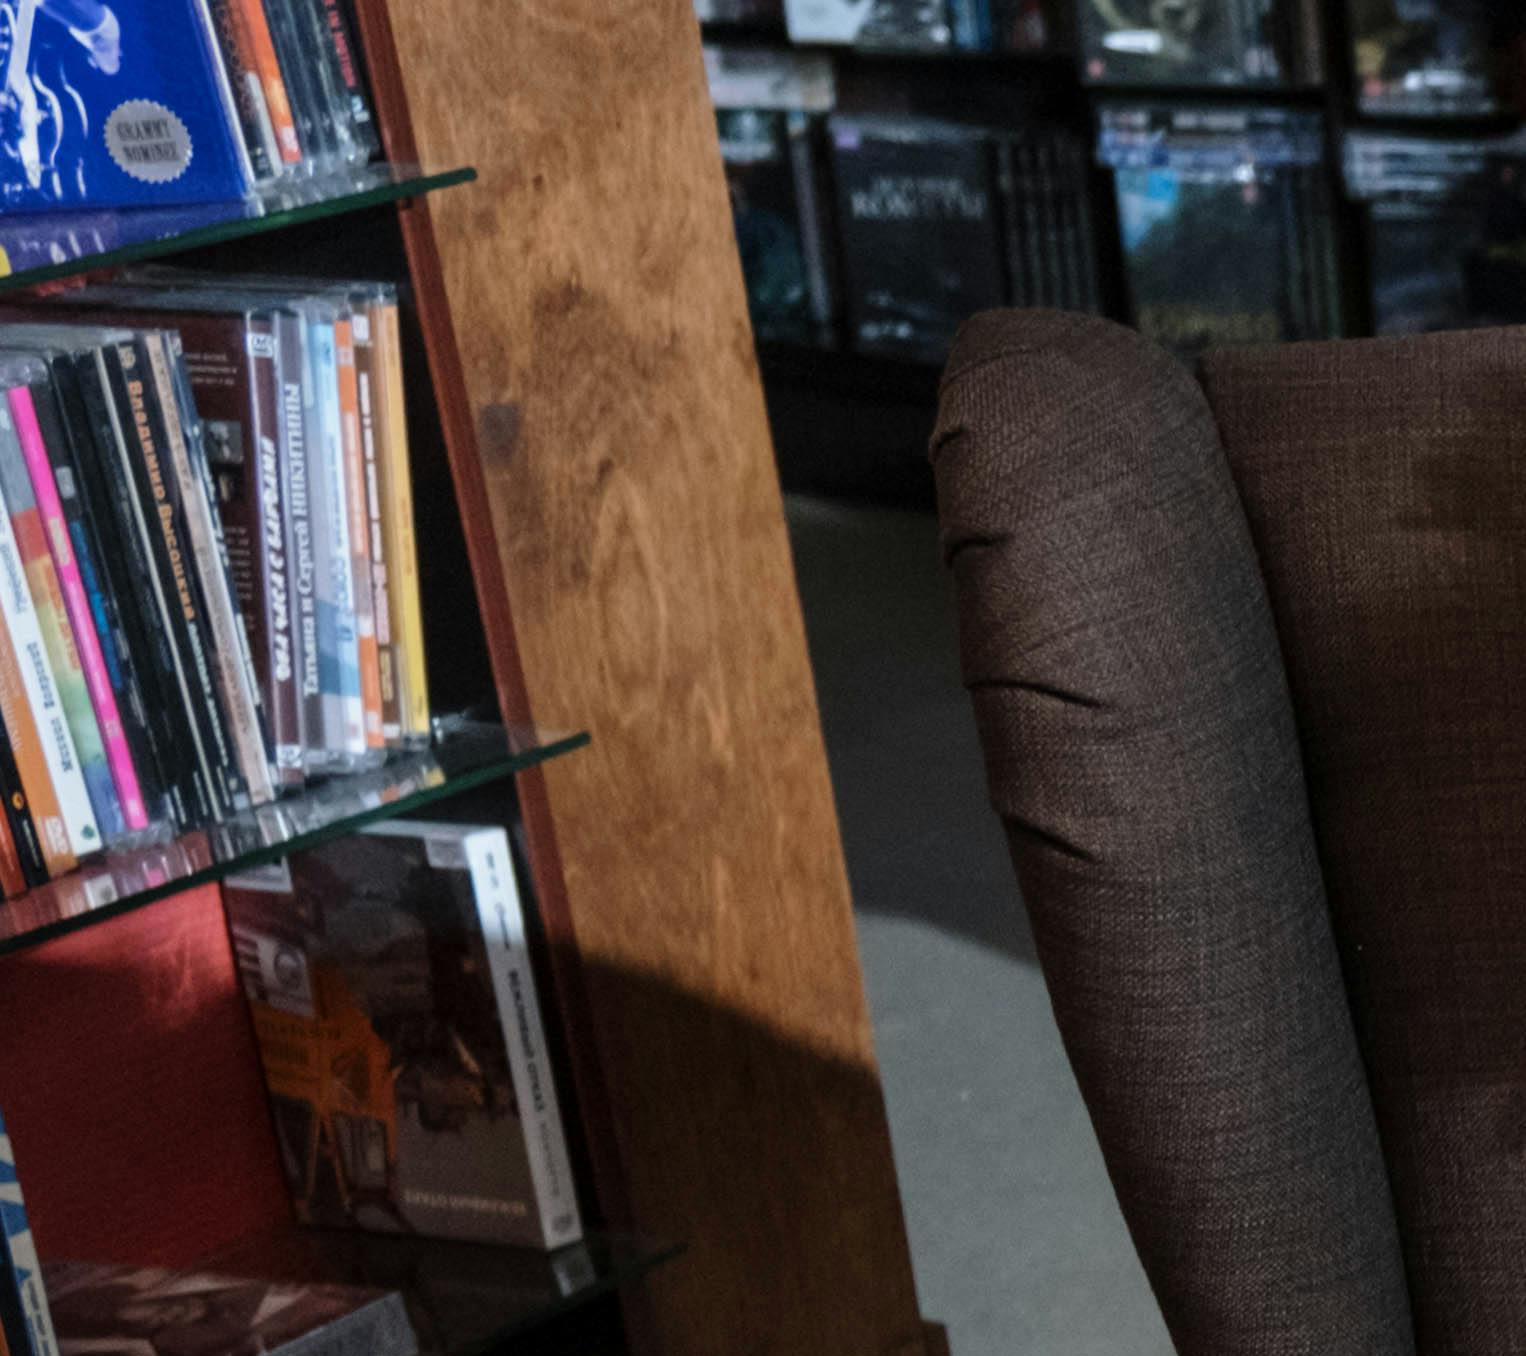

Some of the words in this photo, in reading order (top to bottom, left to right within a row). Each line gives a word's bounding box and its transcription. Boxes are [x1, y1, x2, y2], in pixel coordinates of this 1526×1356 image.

[115, 119, 171, 142] GRAMMY
[123, 143, 180, 162] NOMINEE
[126, 379, 168, 500] Владимир
[157, 502, 199, 622] Высоцкий
[292, 520, 315, 595] Сергей
[299, 616, 320, 696] Татьяна
